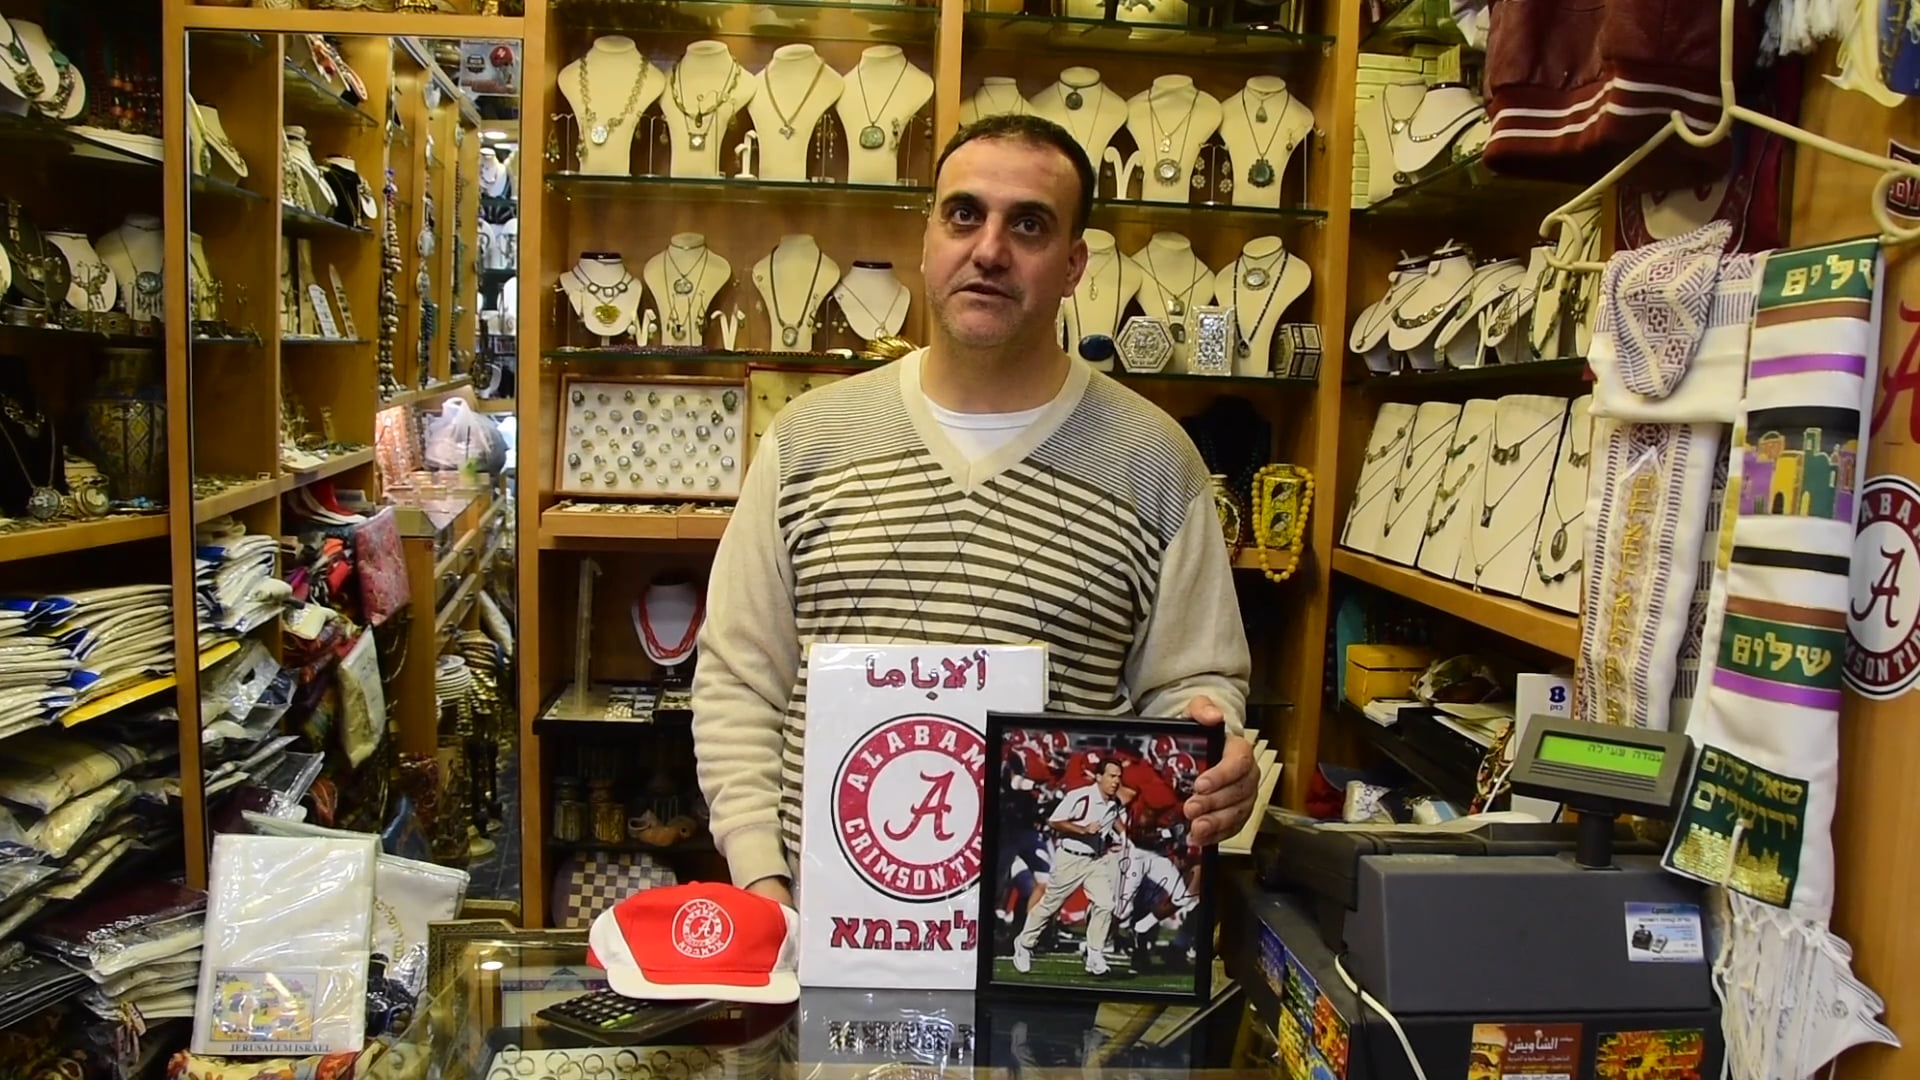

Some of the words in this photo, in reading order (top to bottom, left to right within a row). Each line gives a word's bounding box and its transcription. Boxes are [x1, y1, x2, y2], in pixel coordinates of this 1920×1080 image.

[865, 648, 990, 701] ألاباما
[1732, 632, 1832, 677] שלום
[847, 725, 986, 792] ALABAM
[1702, 750, 1749, 786] שלום
[883, 769, 956, 841] A
[845, 817, 945, 891] CRIMSON
[678, 940, 724, 956] אלאבמא
[830, 910, 977, 951] לאבמא
[230, 1043, 295, 1053] JERUSALEM
[295, 1043, 332, 1053] ISRAEL
